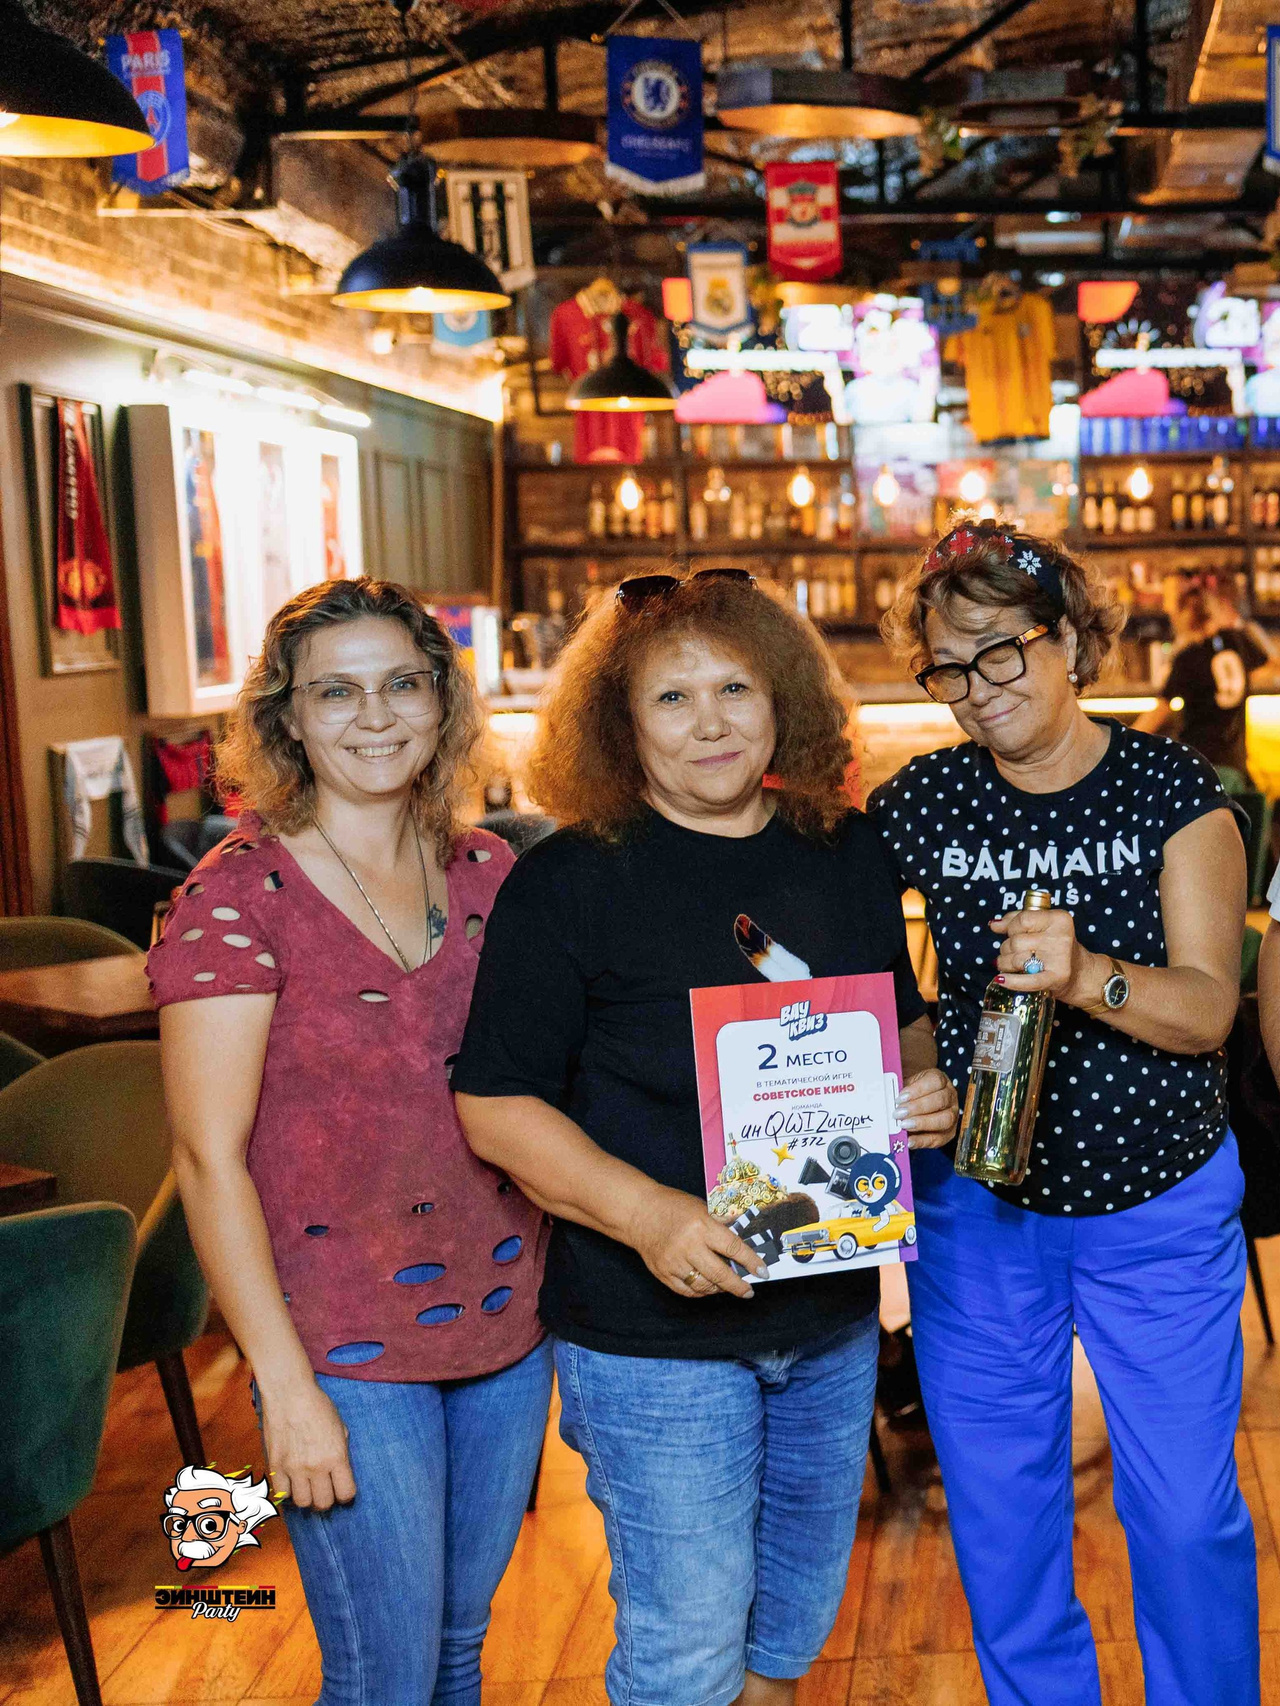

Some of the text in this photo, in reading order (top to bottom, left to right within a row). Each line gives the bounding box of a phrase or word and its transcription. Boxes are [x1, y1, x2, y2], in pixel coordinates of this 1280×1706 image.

[121, 49, 170, 70] PARIS
[942, 834, 1140, 882] BALMAIN
[1002, 887, 1080, 910] PIS
[789, 1012, 828, 1041] КВИЗ
[757, 1044, 847, 1070] 2 МЕСТО
[764, 1073, 831, 1088] ТЕМАТИЧЕСКОЙ
[832, 1071, 853, 1081] ИГРЕ
[753, 1083, 855, 1102] СОВЕТСКОЕ КИНО
[791, 1102, 823, 1111] КОМАНДА
[788, 1137, 826, 1151] #372
